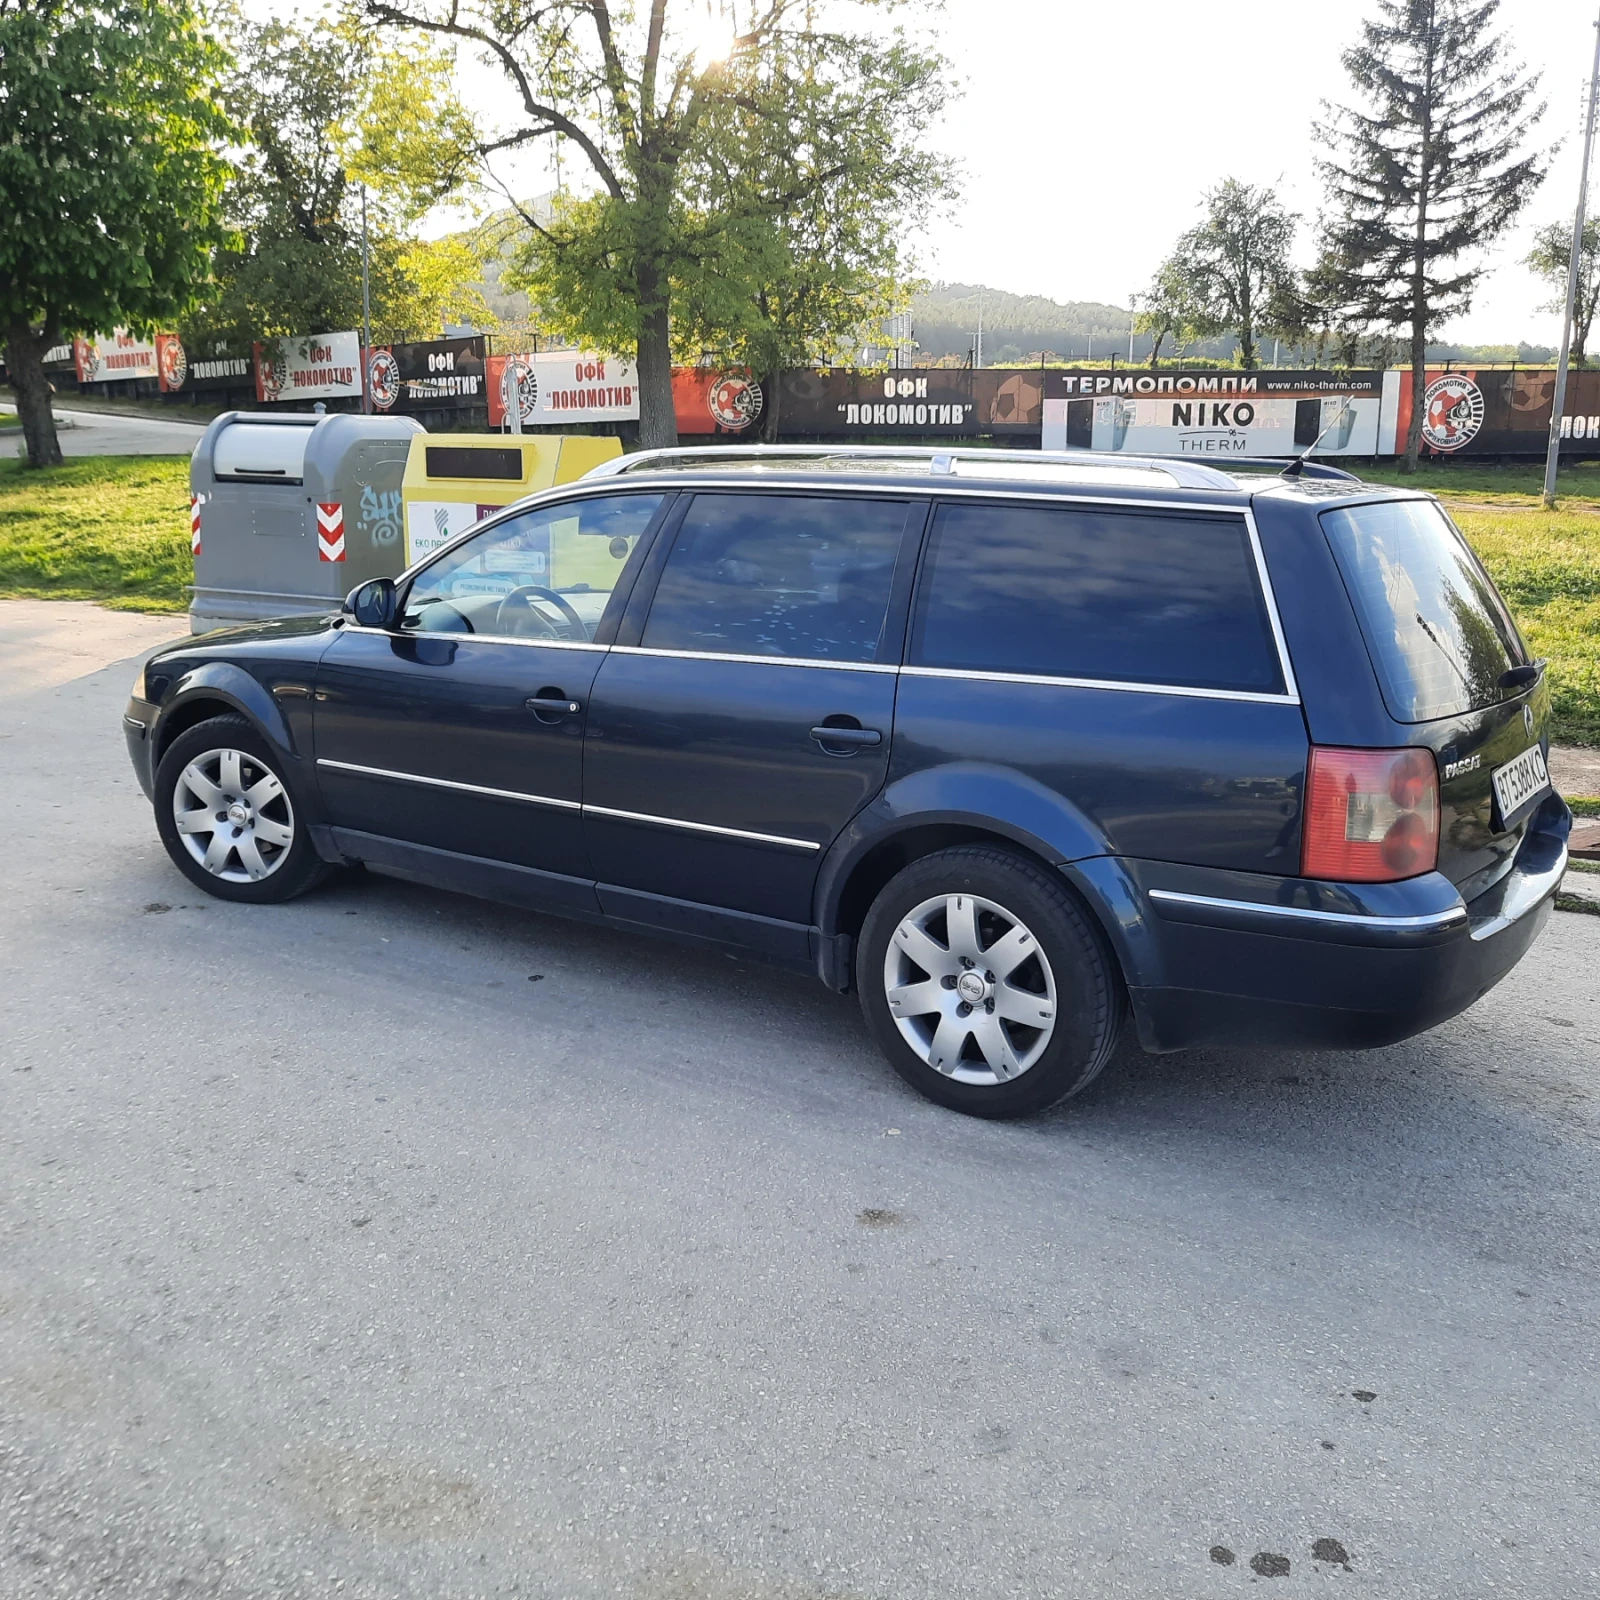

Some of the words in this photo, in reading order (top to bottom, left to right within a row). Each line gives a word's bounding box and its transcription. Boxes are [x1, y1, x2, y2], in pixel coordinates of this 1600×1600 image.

[428, 352, 454, 372] ОФК
[575, 362, 605, 382] ОФК
[883, 377, 928, 398] ОФК
[1062, 376, 1257, 394] ТЕРМОПОМПИ
[1267, 380, 1372, 390] www.niko-therm.com
[1172, 402, 1255, 427] NIKO
[1179, 439, 1246, 451] THERM
[415, 539, 430, 548] ЕКО
[1445, 753, 1482, 780] PASSAT
